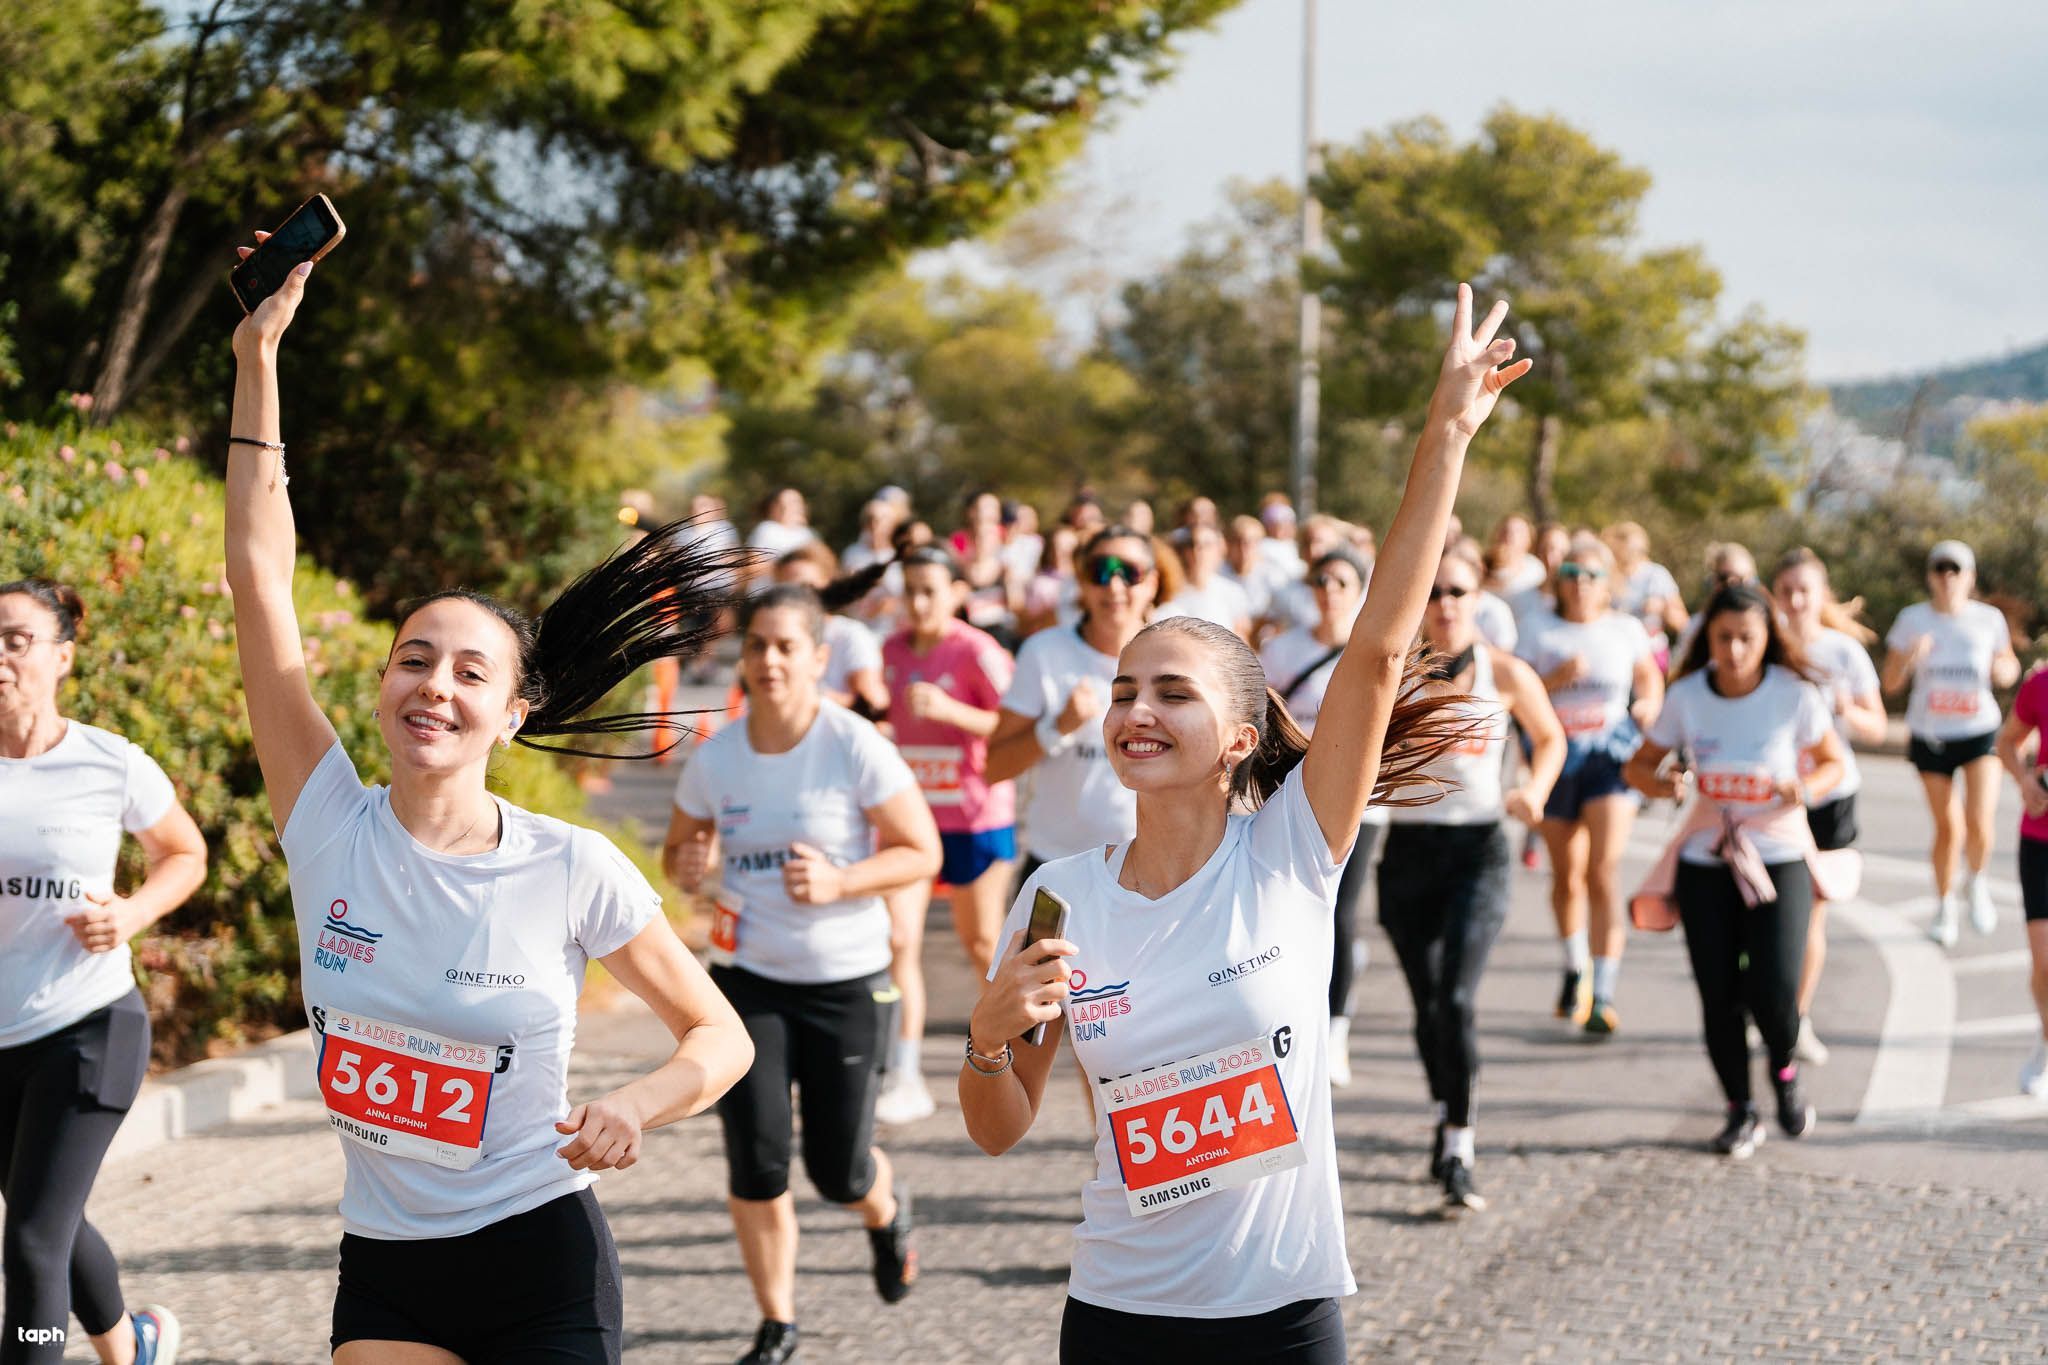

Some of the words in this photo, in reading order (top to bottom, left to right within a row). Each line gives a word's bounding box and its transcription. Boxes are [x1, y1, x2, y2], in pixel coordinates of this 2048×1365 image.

[0, 876, 81, 899] SUNG
[314, 947, 348, 974] RUN
[317, 930, 376, 964] LADIES
[446, 968, 525, 985] QINETIKO
[1208, 946, 1280, 983] QINETIKO
[1071, 996, 1132, 1024] LADIES
[354, 1021, 406, 1048] LADIES
[407, 1035, 441, 1057] RUN
[442, 1044, 486, 1065] 2025
[1074, 1021, 1106, 1042] RUN
[330, 1050, 474, 1124] 5612
[1124, 1072, 1180, 1101] LADIES
[1179, 1061, 1217, 1085] RUN
[1216, 1047, 1263, 1073] 2025
[329, 1115, 388, 1146] SAMSUNG
[1126, 1082, 1276, 1165] 5644
[1140, 1177, 1211, 1208] SAMSUNG
